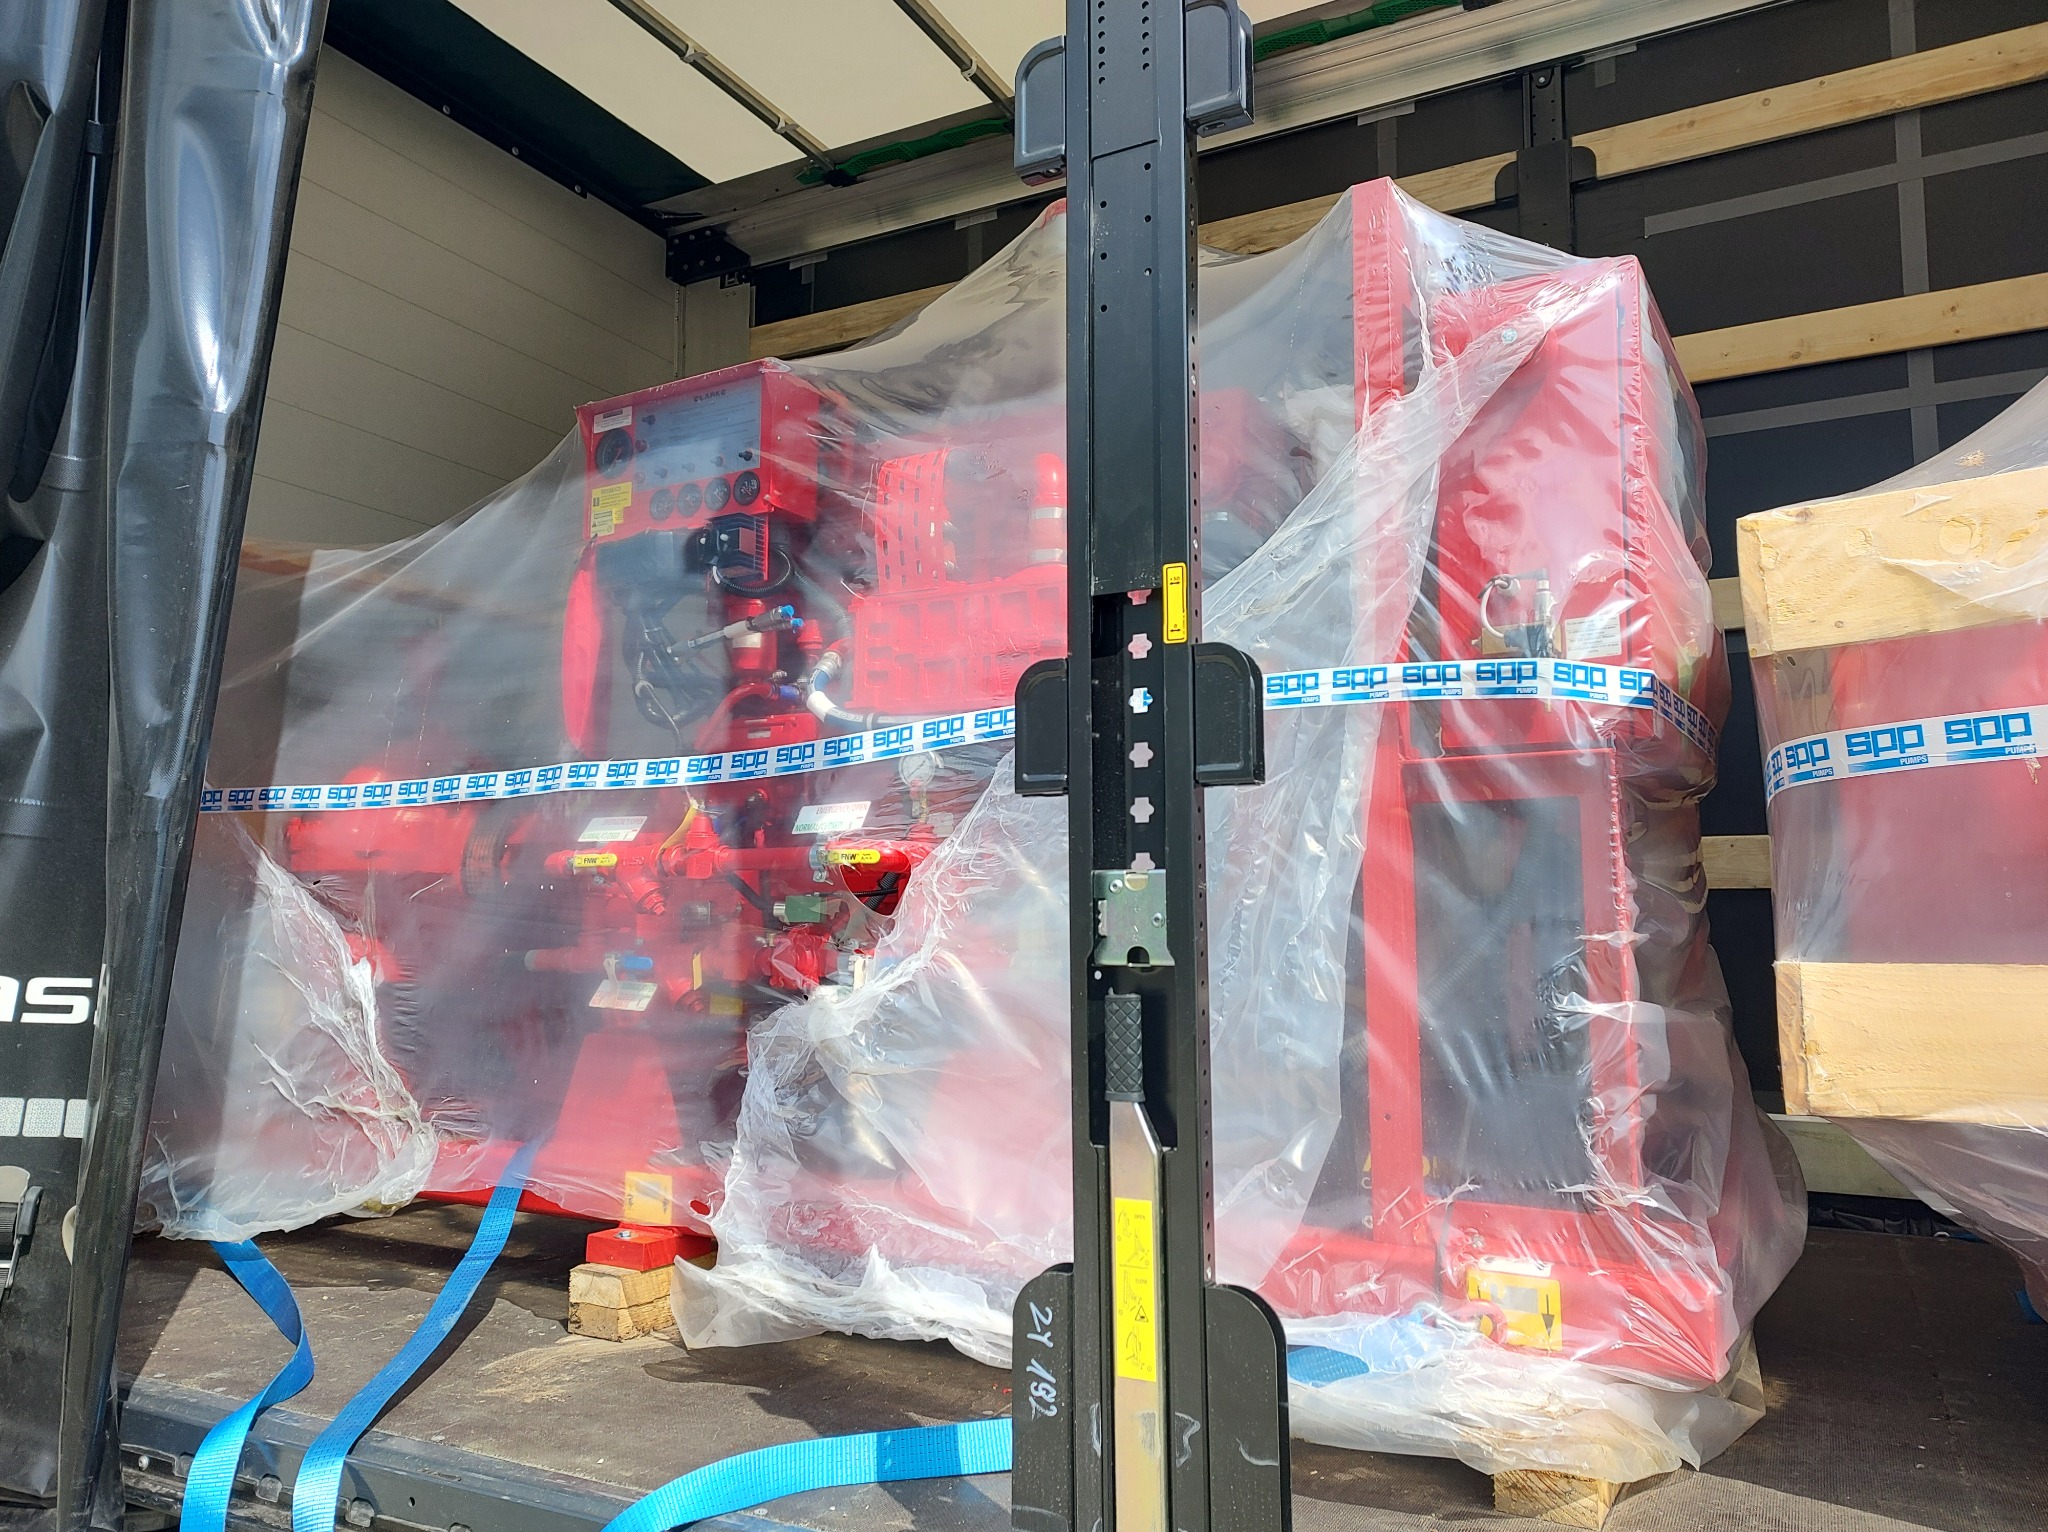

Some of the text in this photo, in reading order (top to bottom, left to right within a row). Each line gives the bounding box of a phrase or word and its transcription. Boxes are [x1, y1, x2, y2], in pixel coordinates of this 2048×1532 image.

[1813, 744, 2036, 777] PUMPS PUMPS PUMPS
